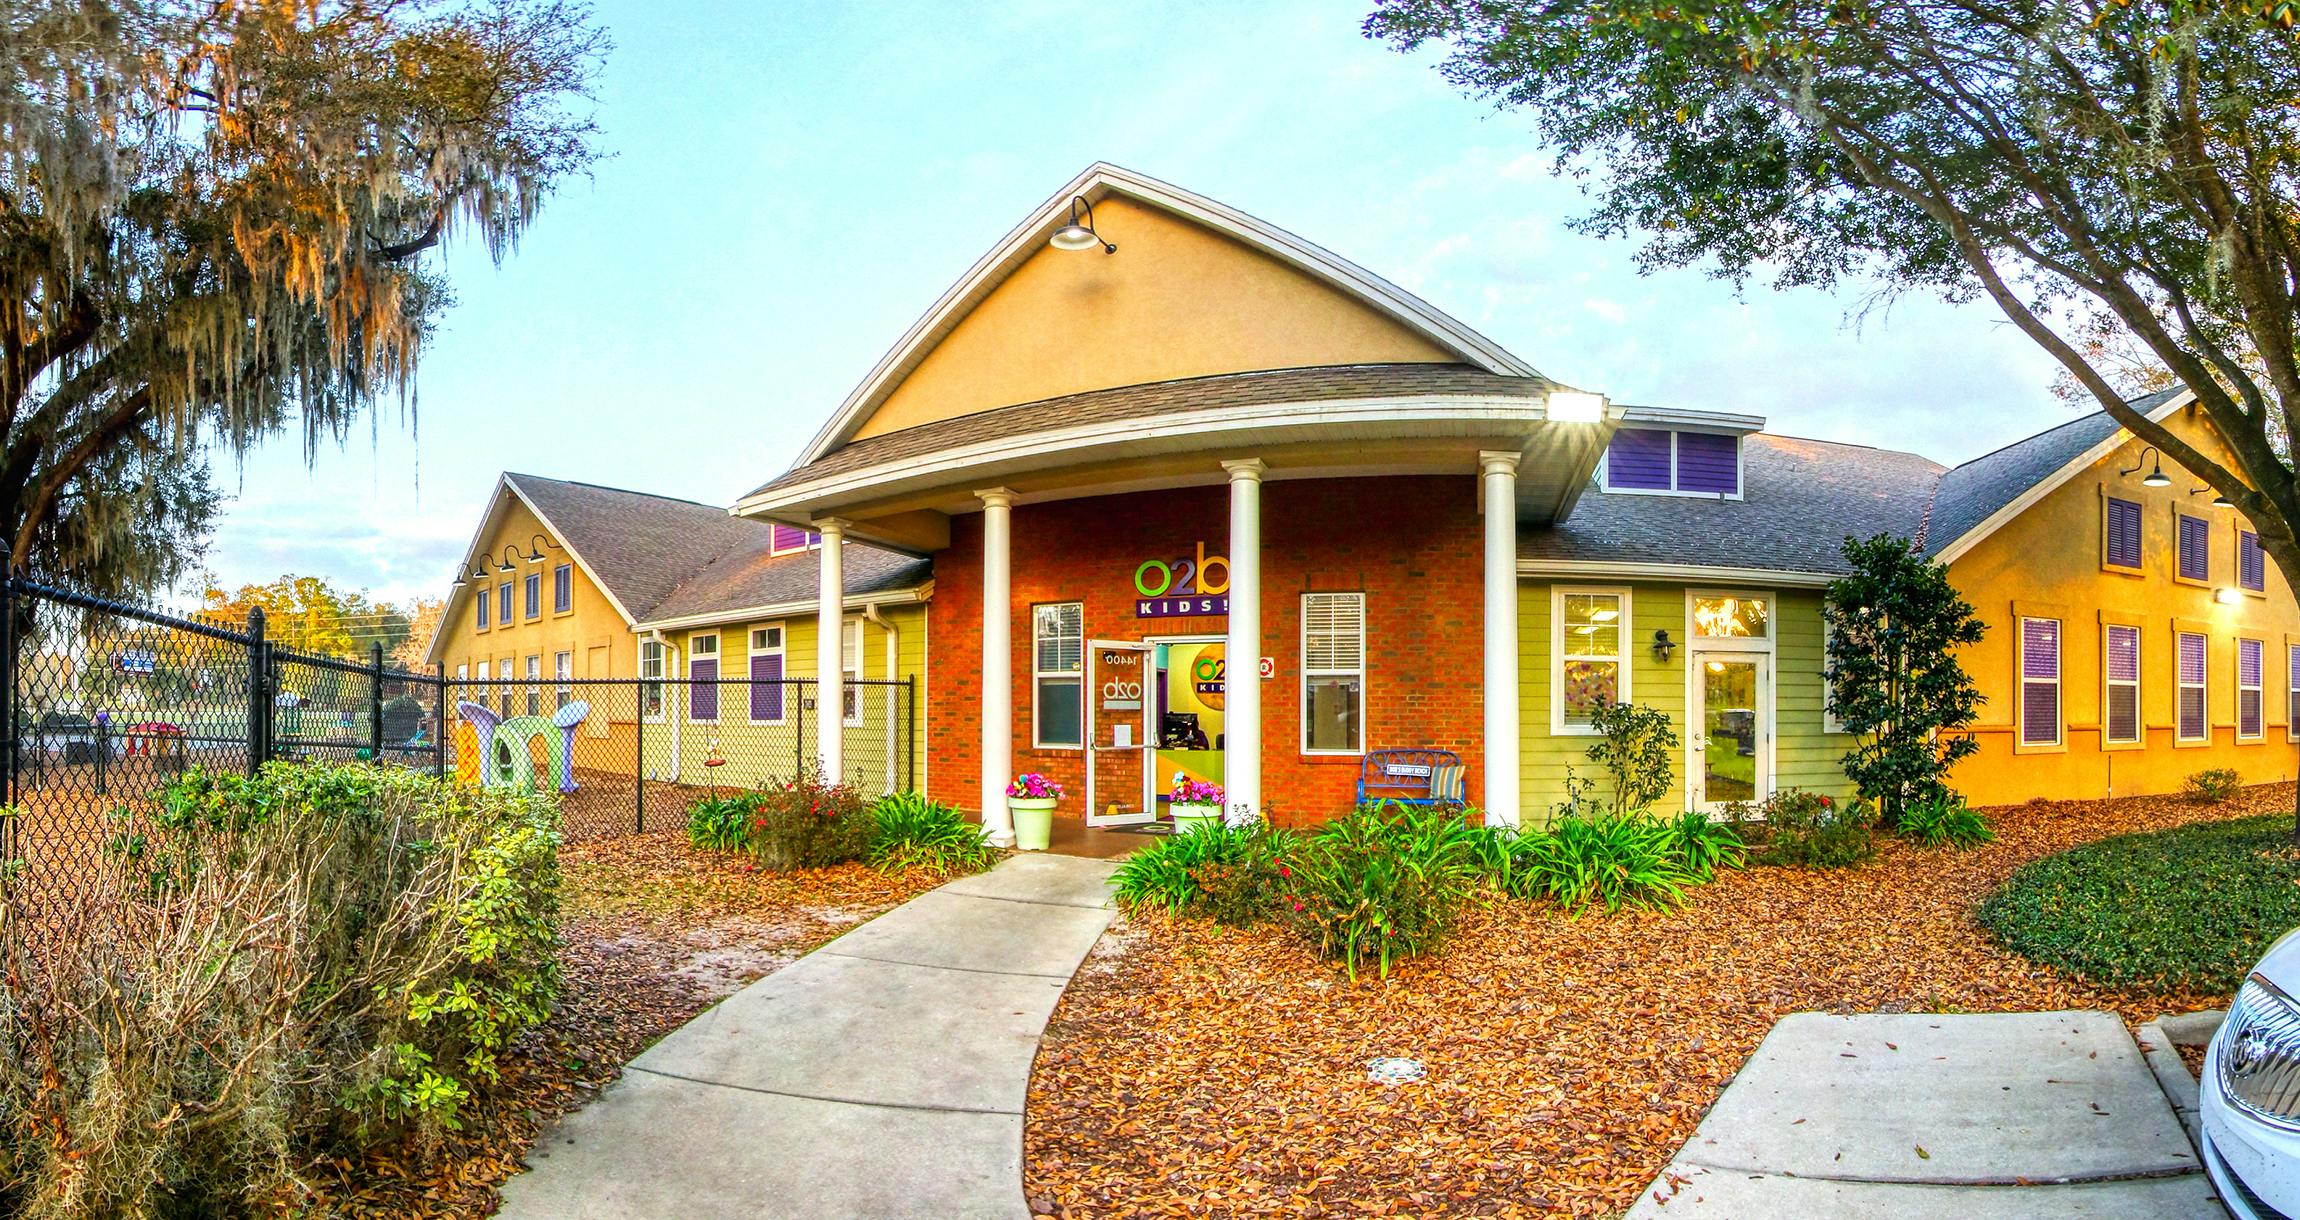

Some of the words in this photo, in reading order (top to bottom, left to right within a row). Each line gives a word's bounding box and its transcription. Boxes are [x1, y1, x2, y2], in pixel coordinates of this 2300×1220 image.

[1135, 541, 1230, 597] o2b
[1140, 600, 1228, 614] KIDS!
[1196, 659, 1225, 680] o2
